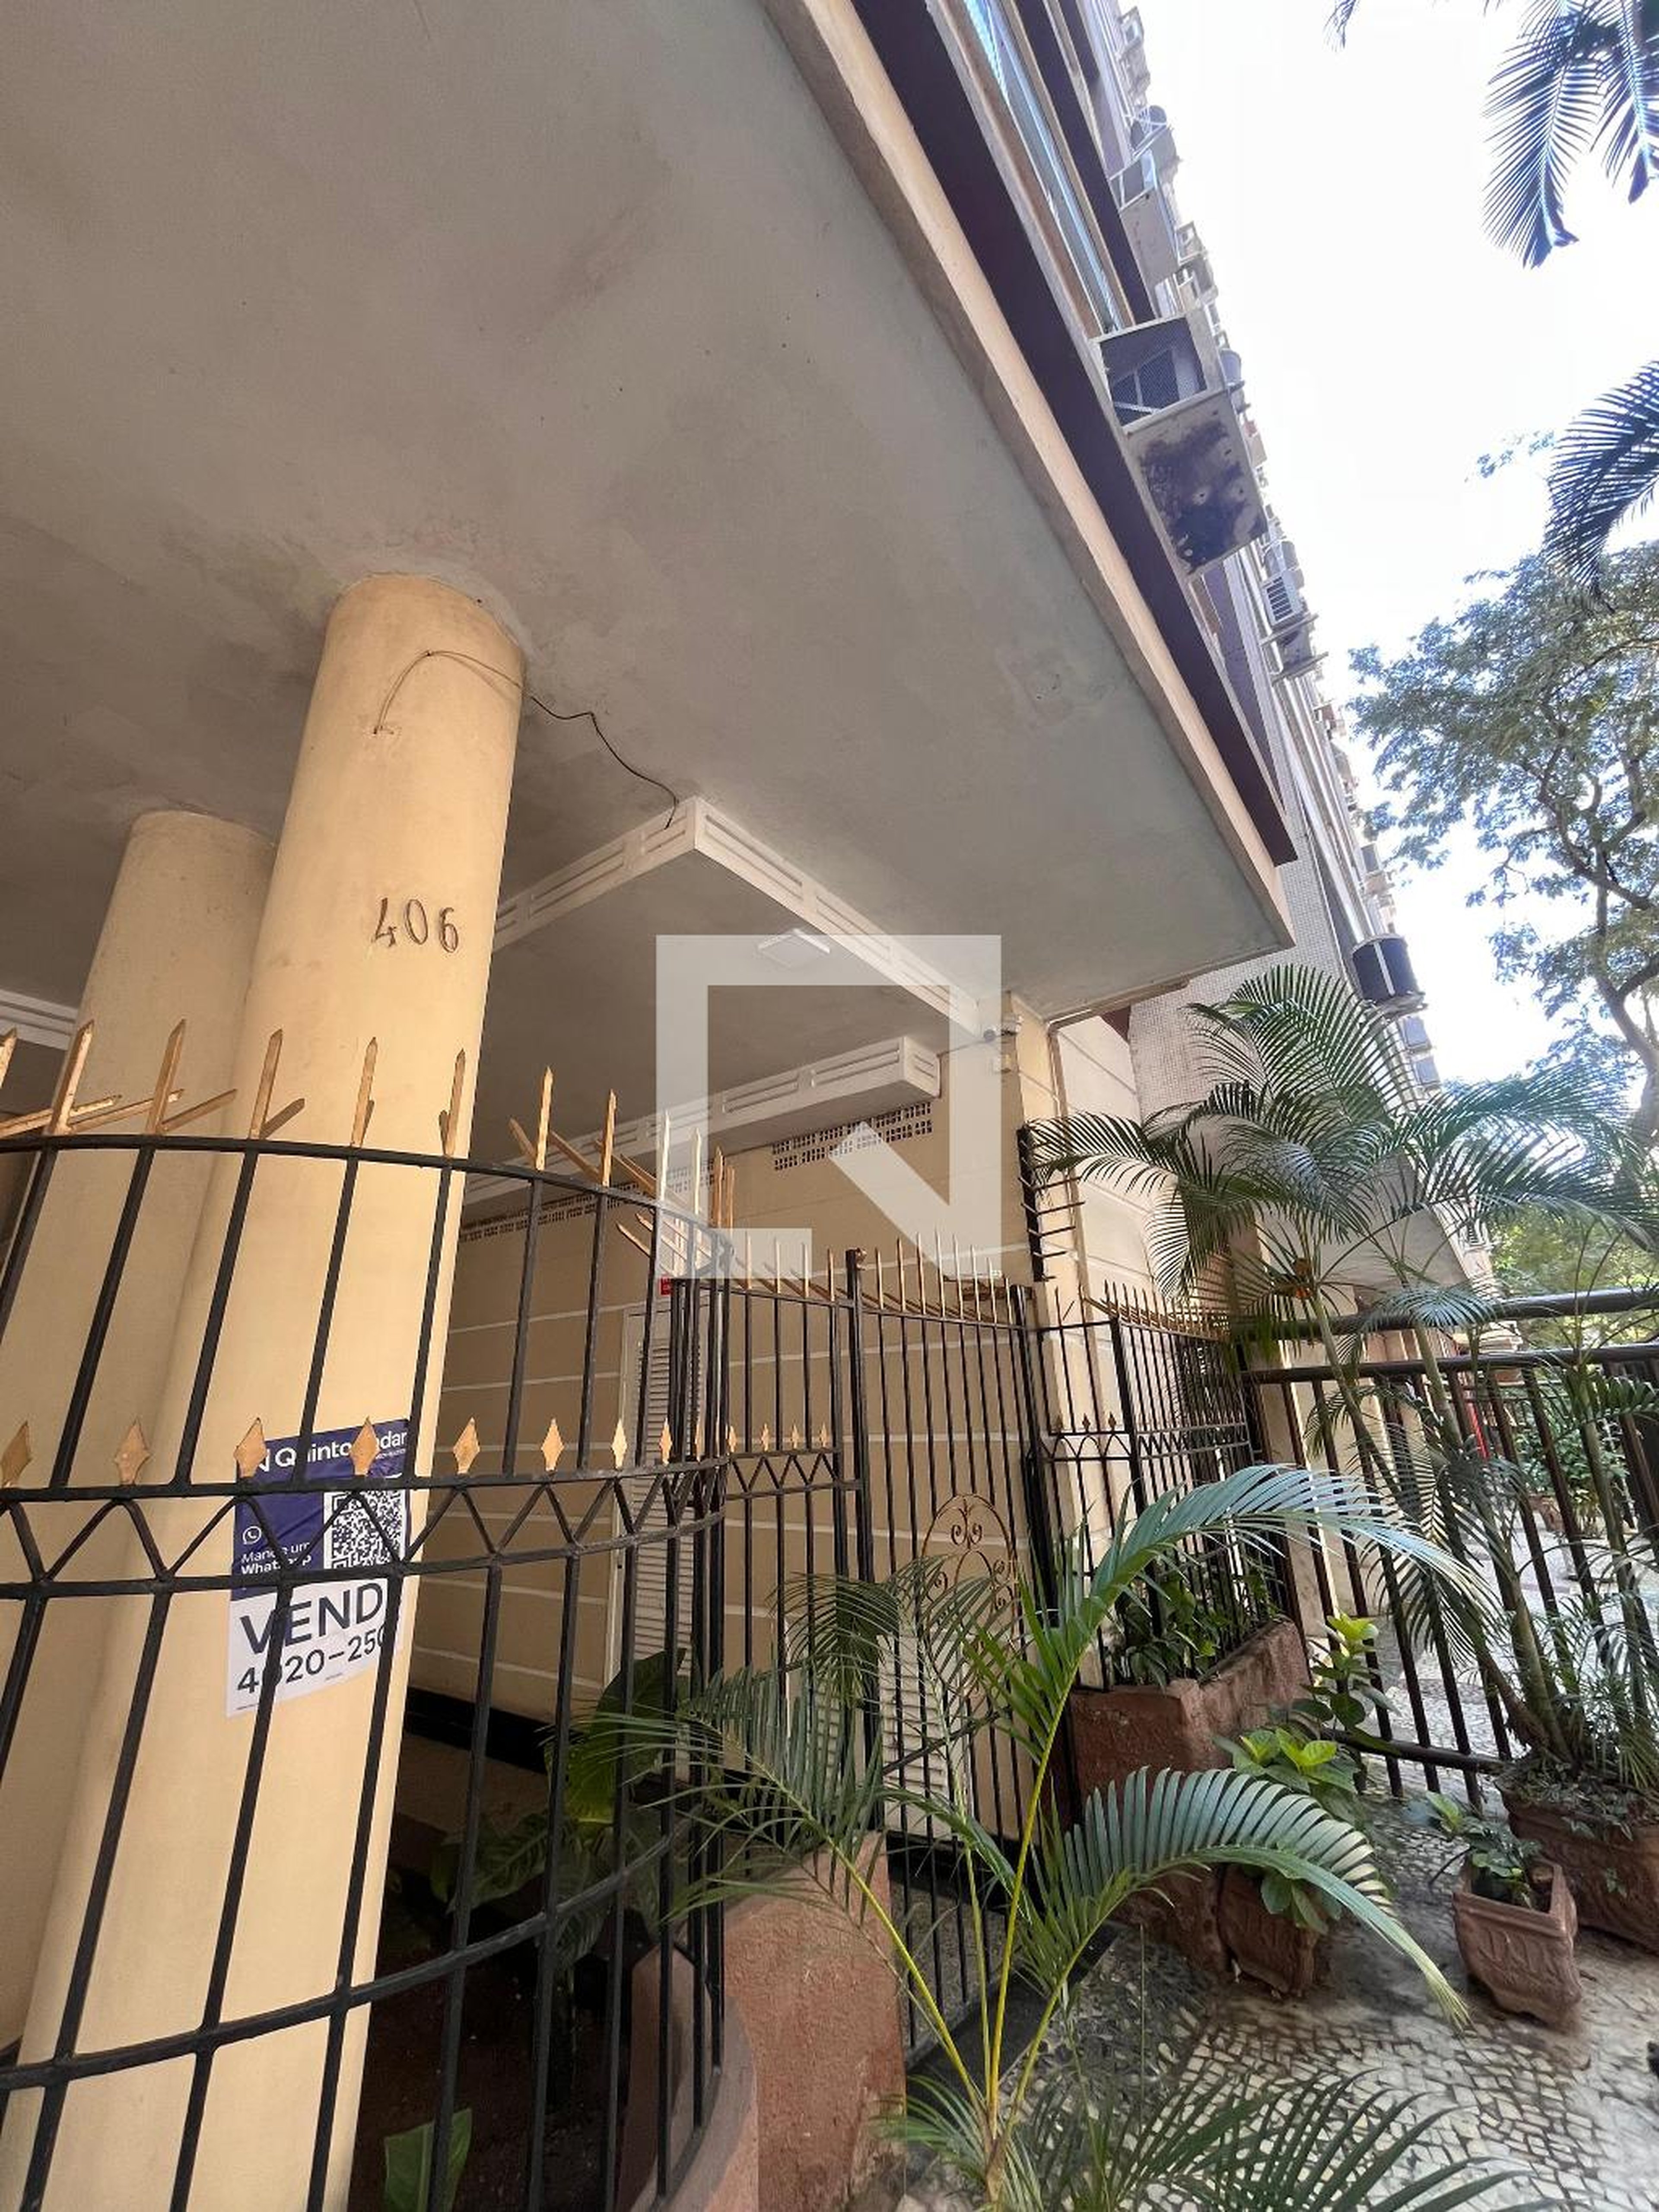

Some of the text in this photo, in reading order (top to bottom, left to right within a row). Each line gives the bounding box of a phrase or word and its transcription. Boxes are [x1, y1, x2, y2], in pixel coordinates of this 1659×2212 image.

[371, 898, 458, 953] 406
[275, 1431, 407, 1467] Qintodar
[239, 1583, 384, 1654] VEND
